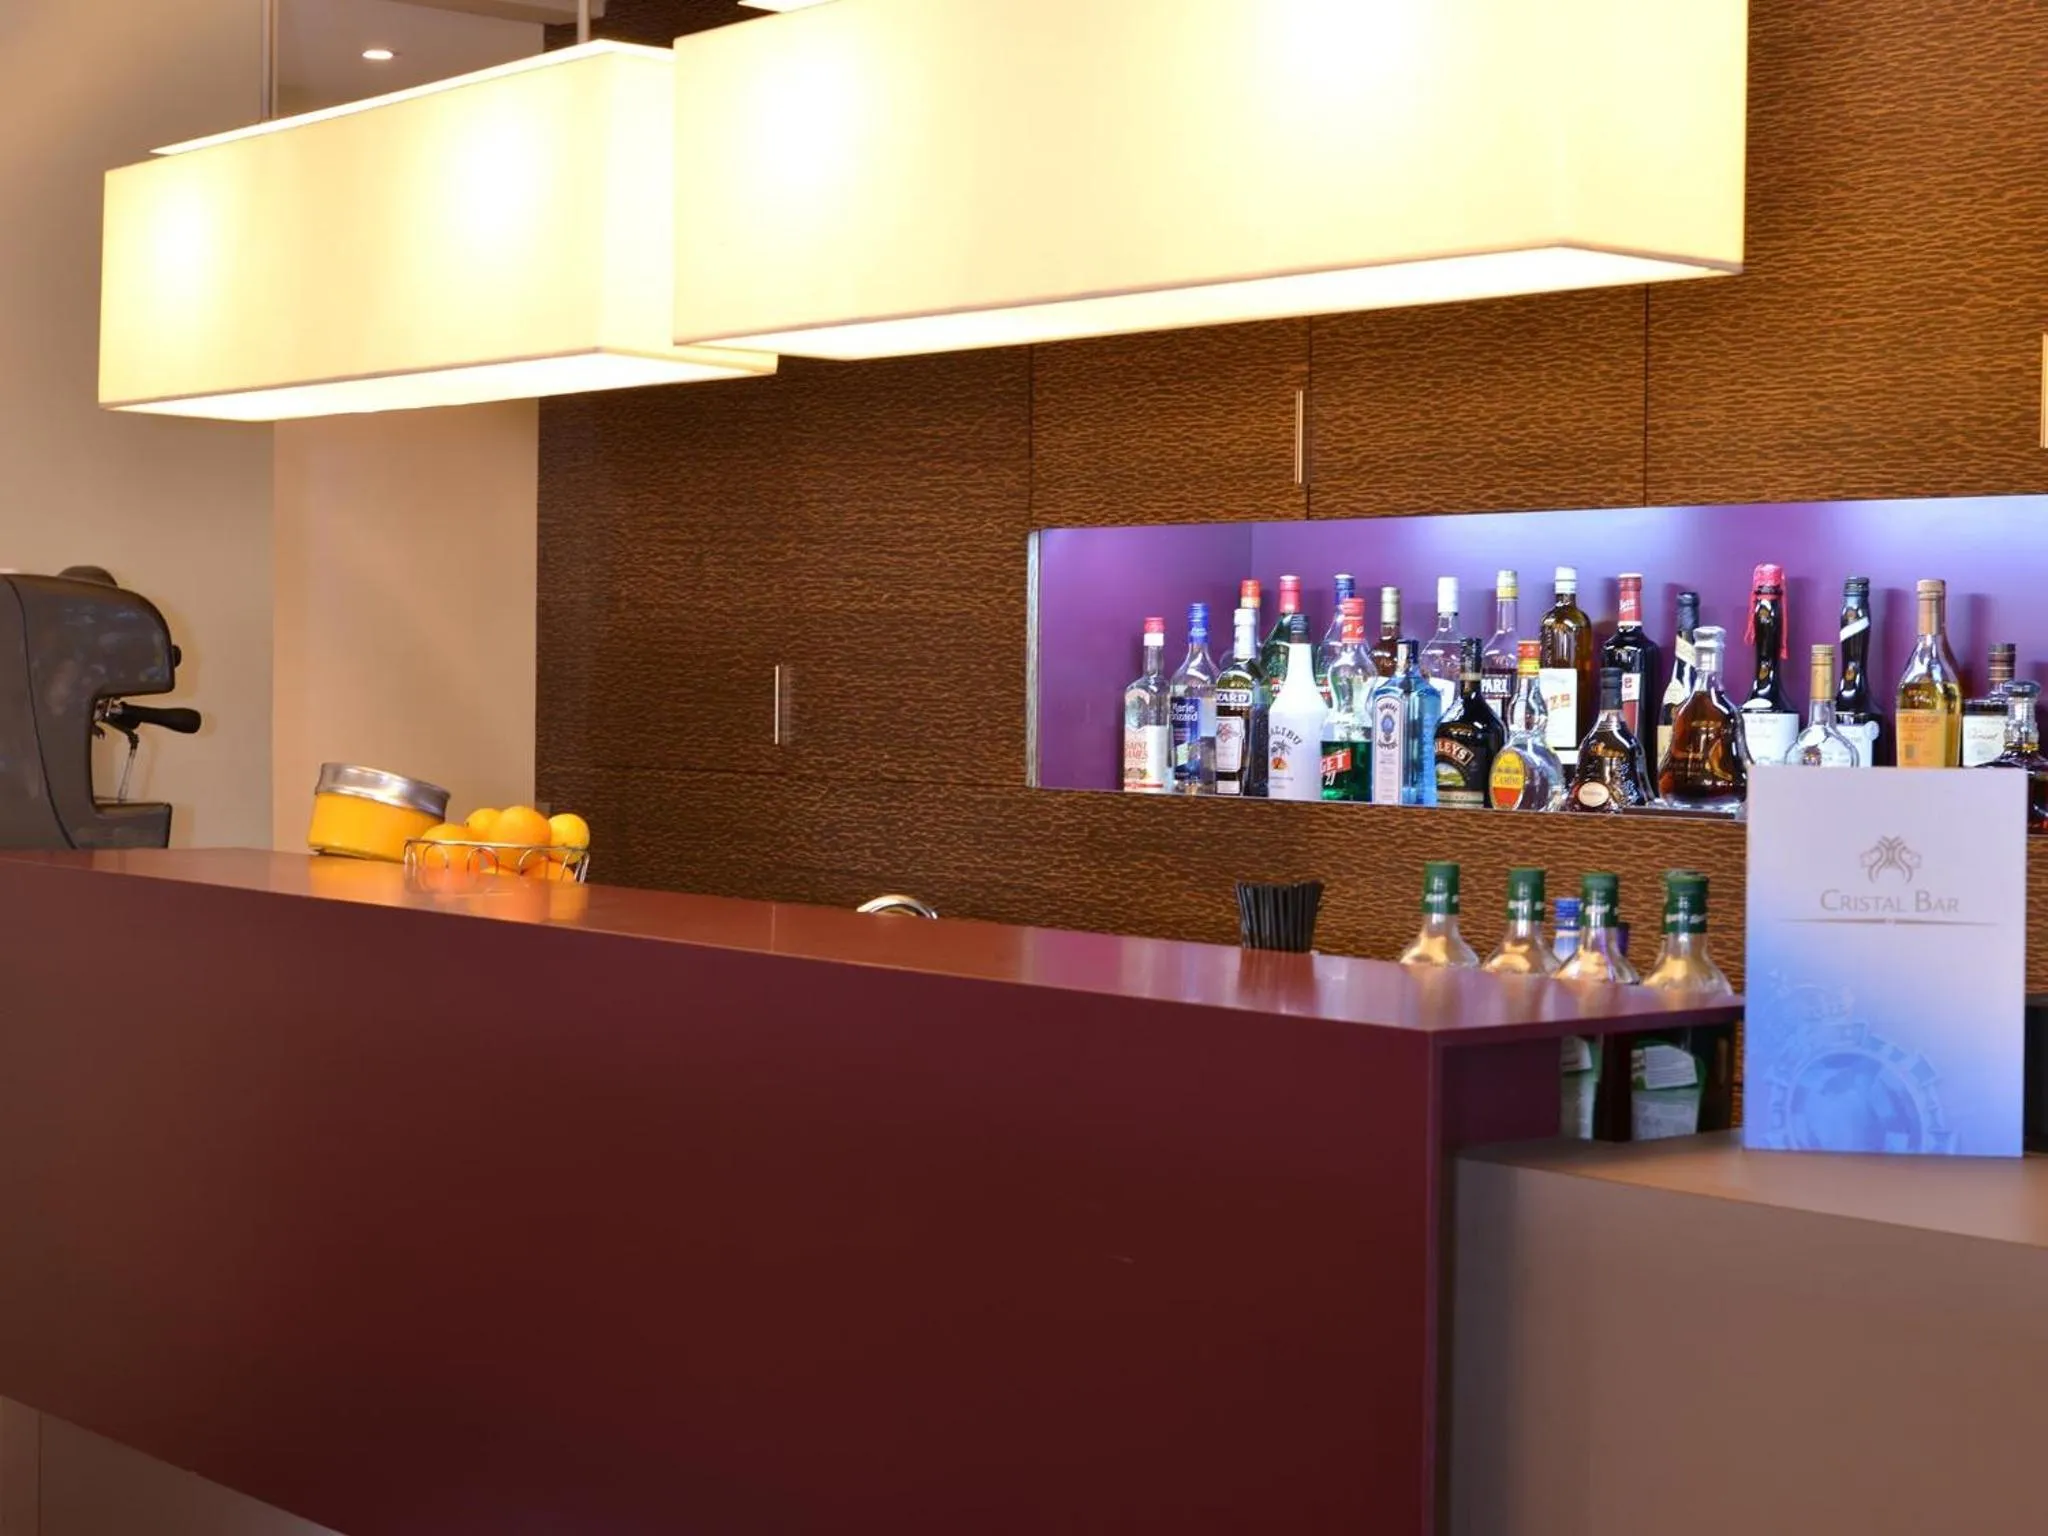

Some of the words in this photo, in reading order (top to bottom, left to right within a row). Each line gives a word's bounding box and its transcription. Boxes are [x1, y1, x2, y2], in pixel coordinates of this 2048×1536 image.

[1481, 678, 1509, 693] PARI
[1217, 691, 1248, 703] ARD
[1270, 725, 1303, 746] ALIBU
[1820, 888, 1907, 913] CRISTAL
[1914, 889, 1960, 914] BAR
